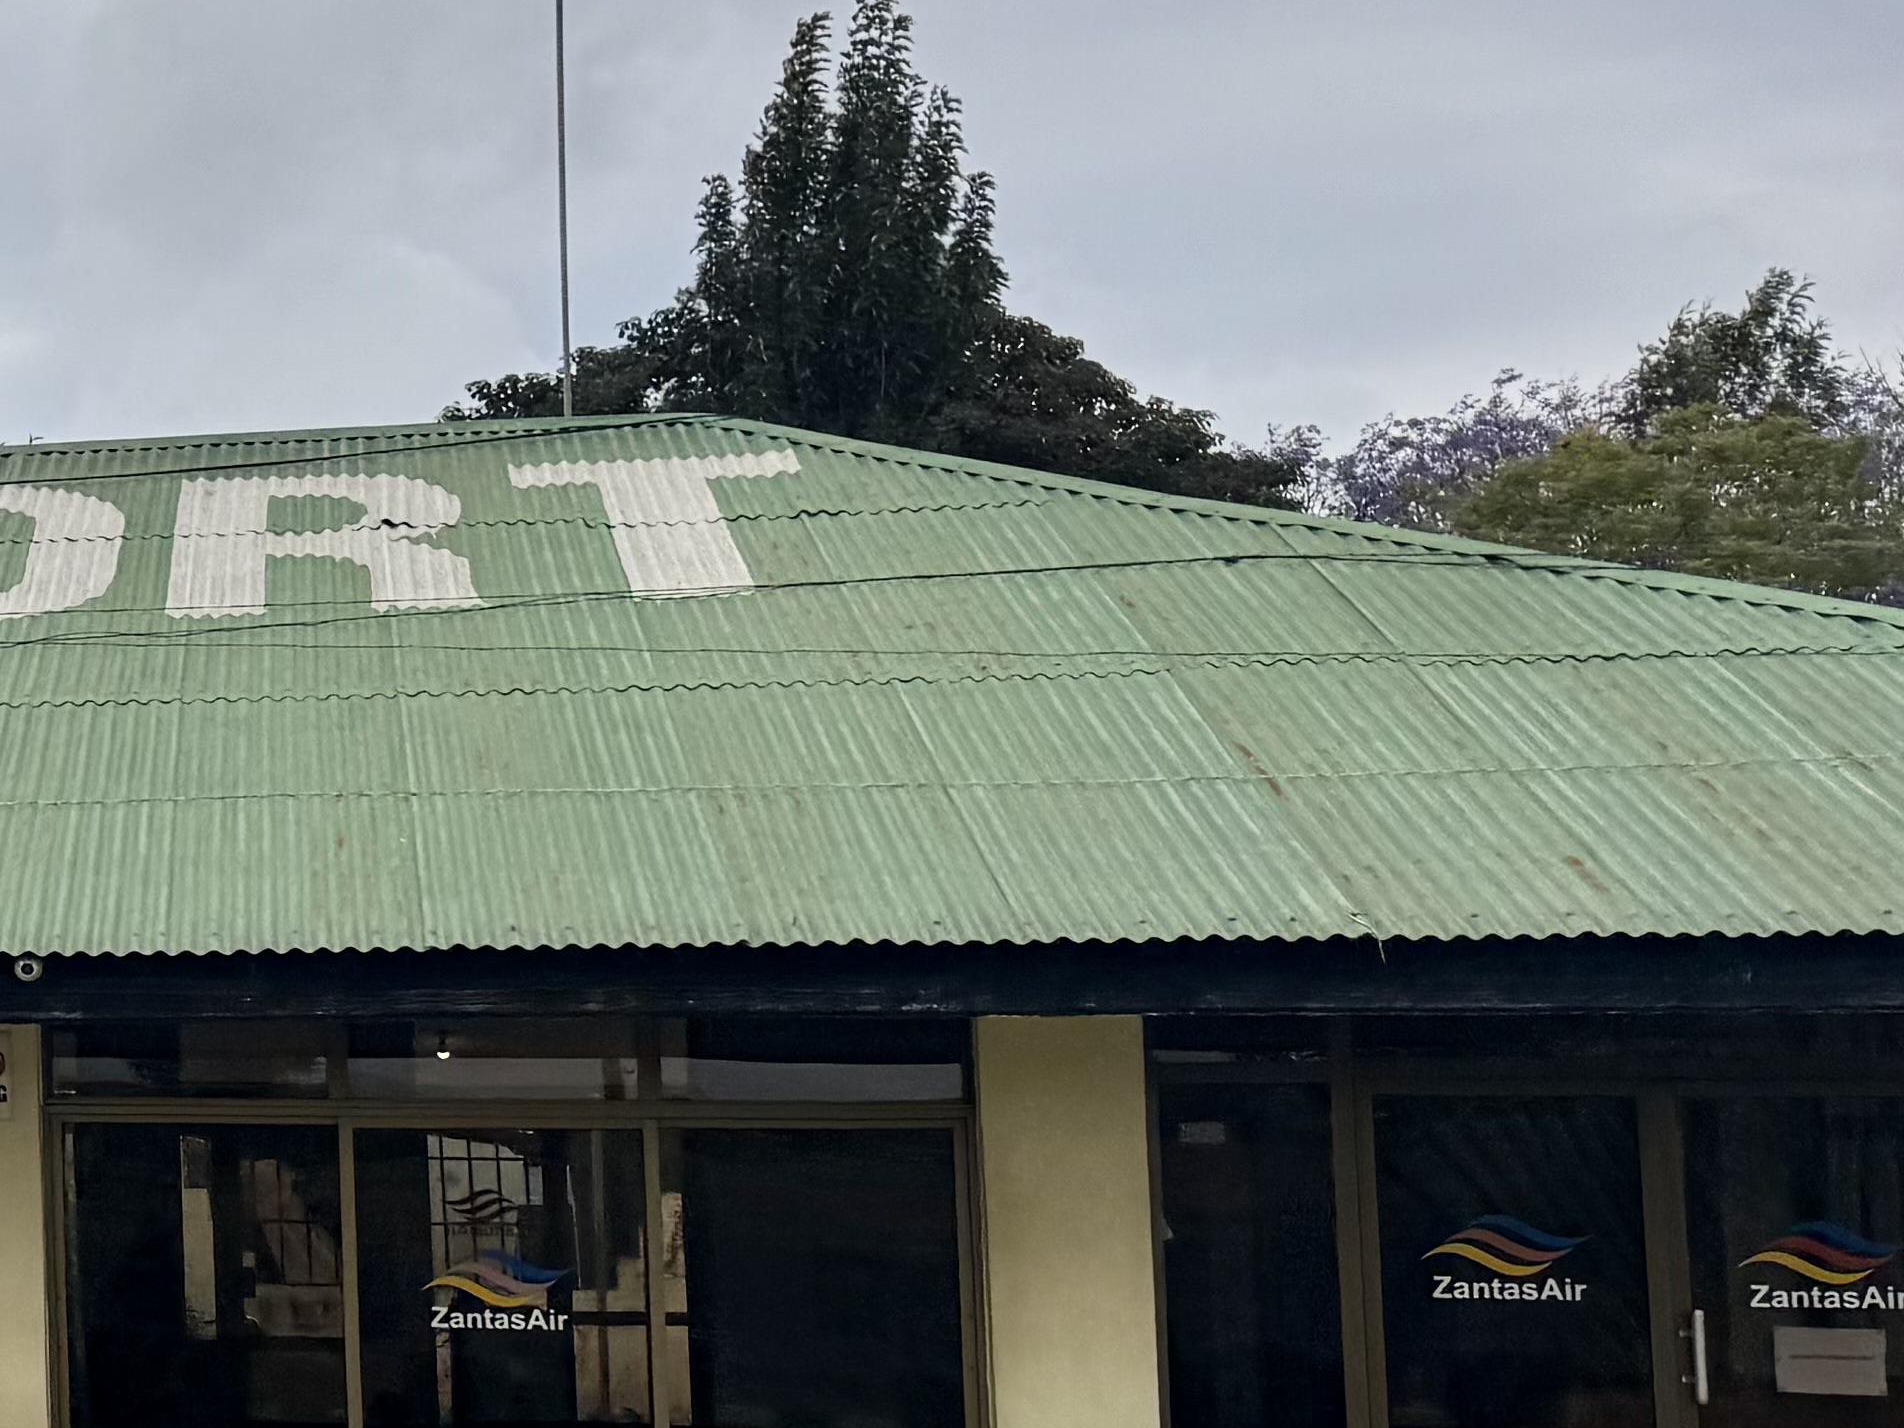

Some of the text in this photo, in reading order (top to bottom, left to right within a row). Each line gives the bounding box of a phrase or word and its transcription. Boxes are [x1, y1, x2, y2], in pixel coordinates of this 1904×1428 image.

[1432, 1275, 1588, 1302] ZantasAir
[1750, 1284, 1904, 1310] ZantasAir
[430, 1306, 569, 1331] ZantasAir
